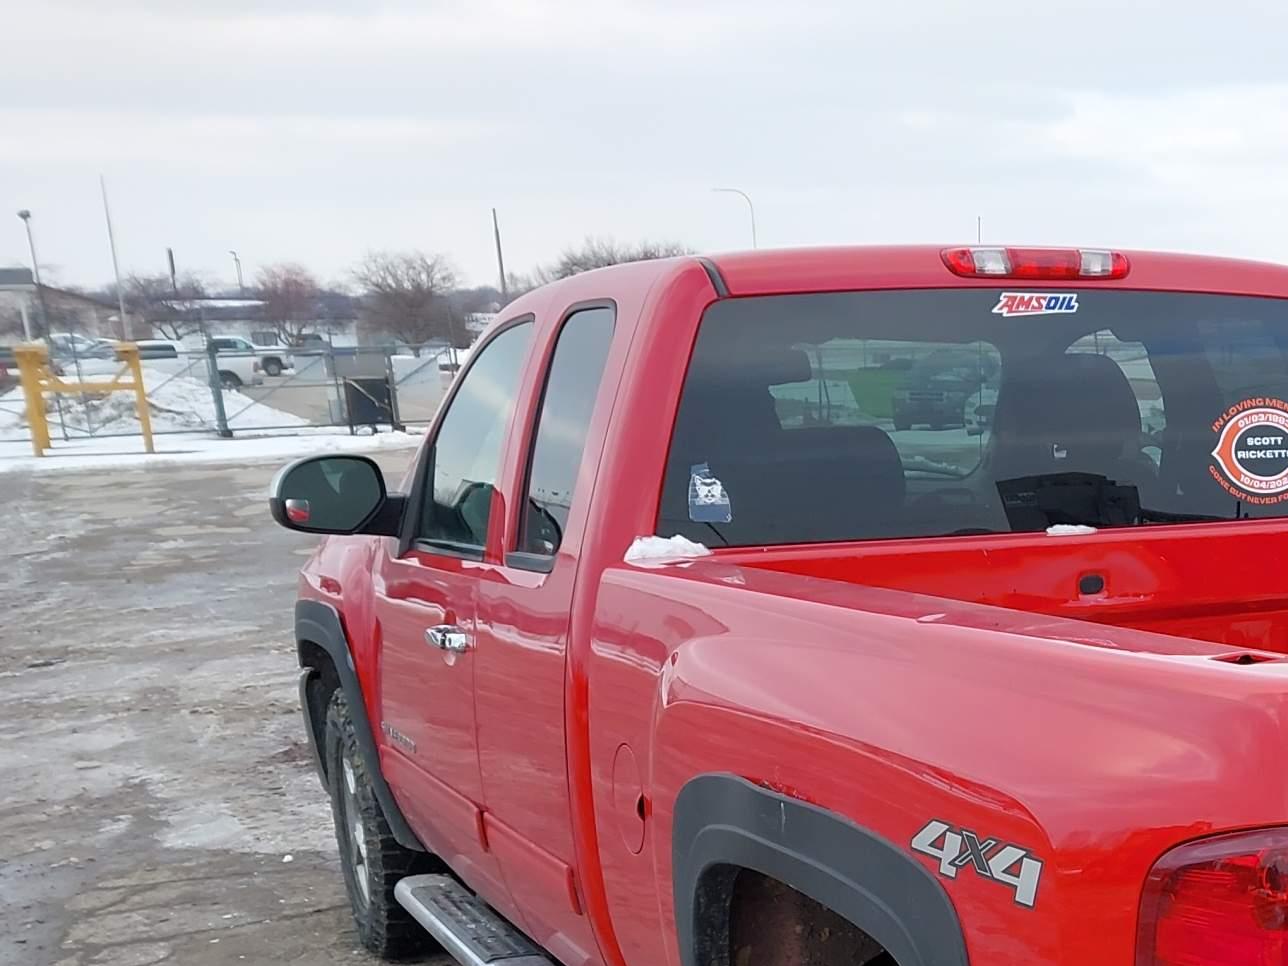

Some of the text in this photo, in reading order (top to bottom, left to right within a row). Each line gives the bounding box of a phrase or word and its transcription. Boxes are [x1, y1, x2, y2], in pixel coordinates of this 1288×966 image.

[996, 294, 1077, 313] AMSOIL
[1223, 398, 1264, 420] LOVING
[1246, 436, 1283, 446] SCOTT
[1208, 465, 1230, 490] GONE
[1229, 486, 1247, 499] BUT
[1247, 496, 1278, 505] NEVER
